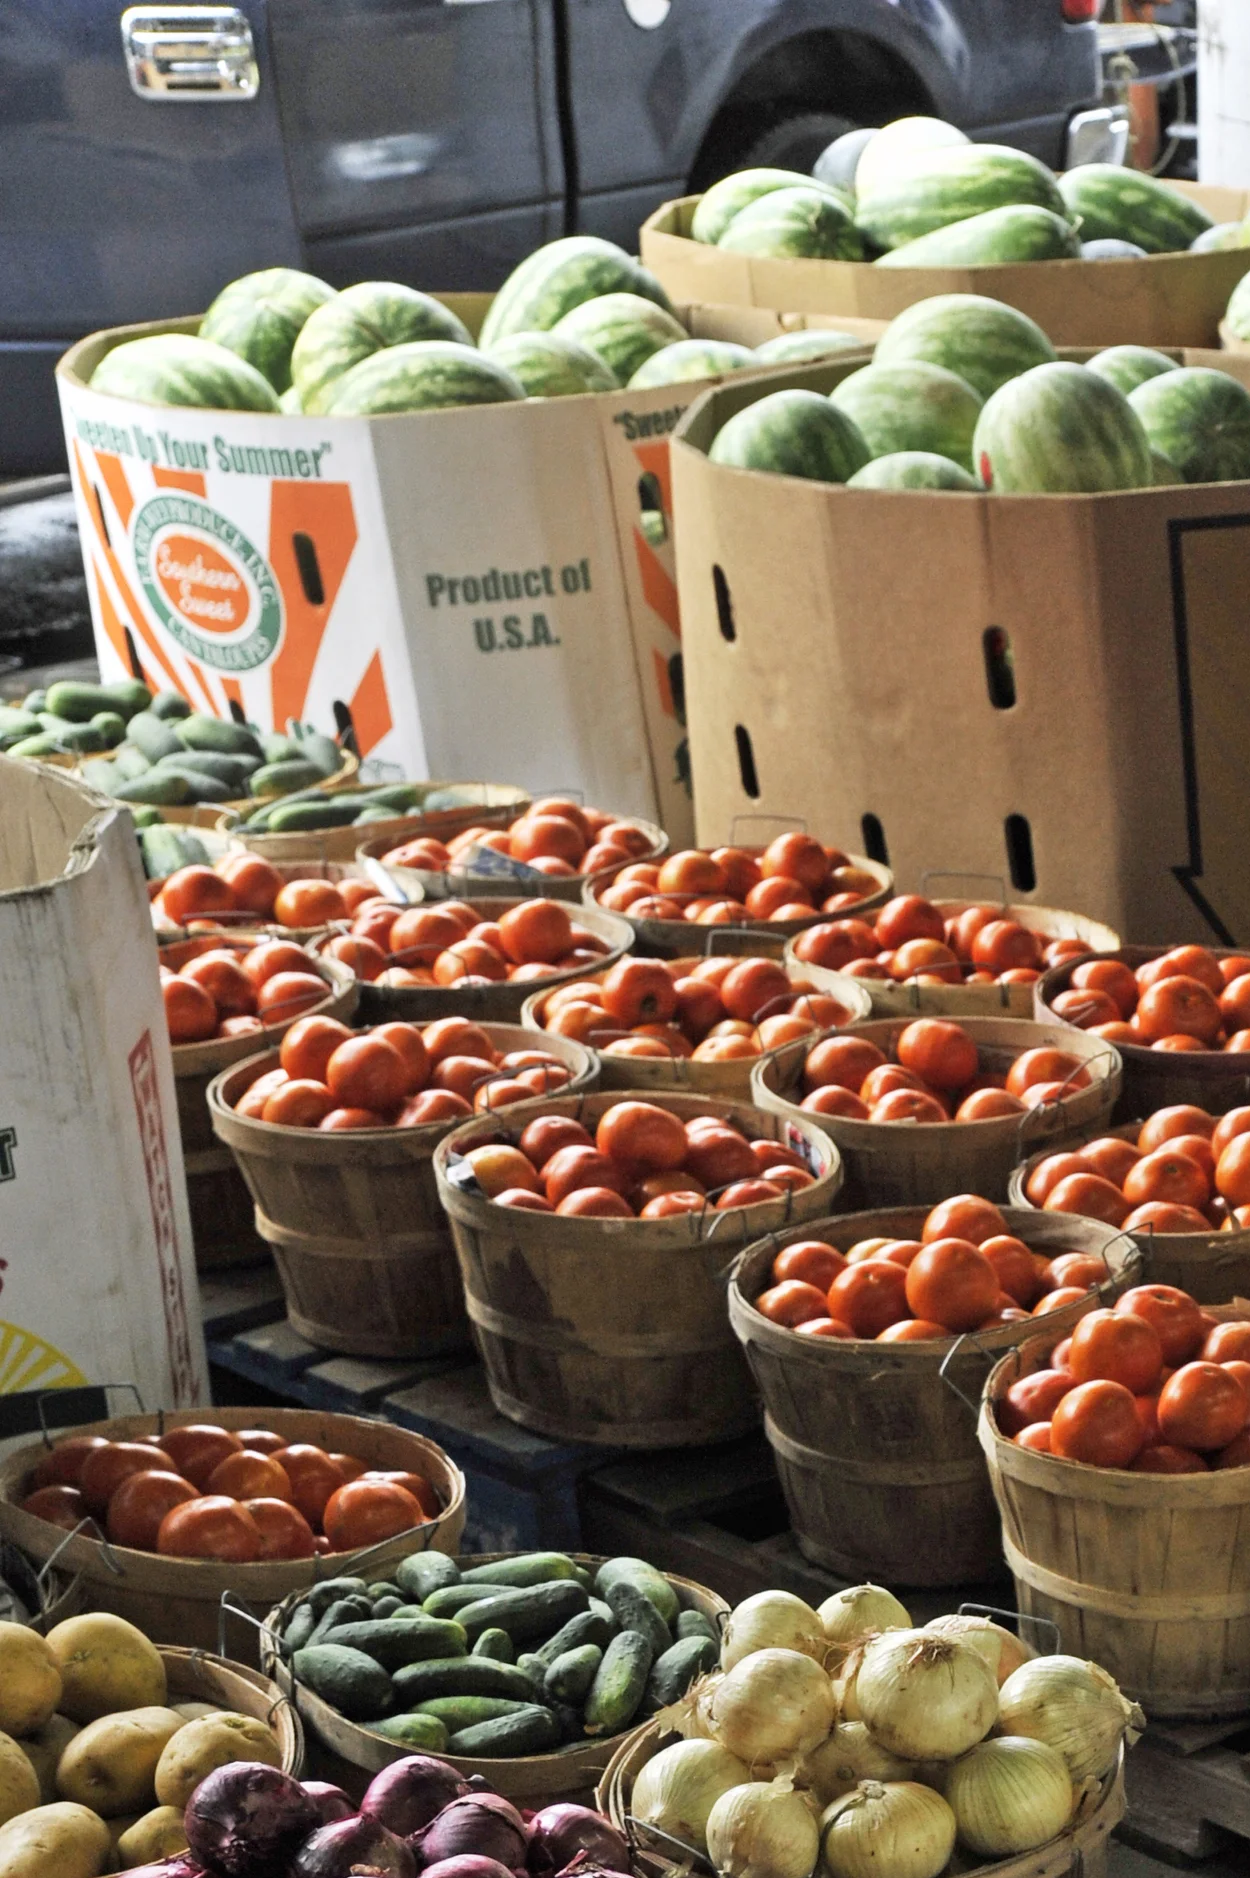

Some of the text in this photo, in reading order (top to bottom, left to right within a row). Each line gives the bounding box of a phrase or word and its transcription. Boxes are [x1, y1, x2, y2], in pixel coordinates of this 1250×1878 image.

[157, 430, 209, 470] Your
[426, 557, 592, 608] Product of
[473, 612, 562, 652] U.S.A.
